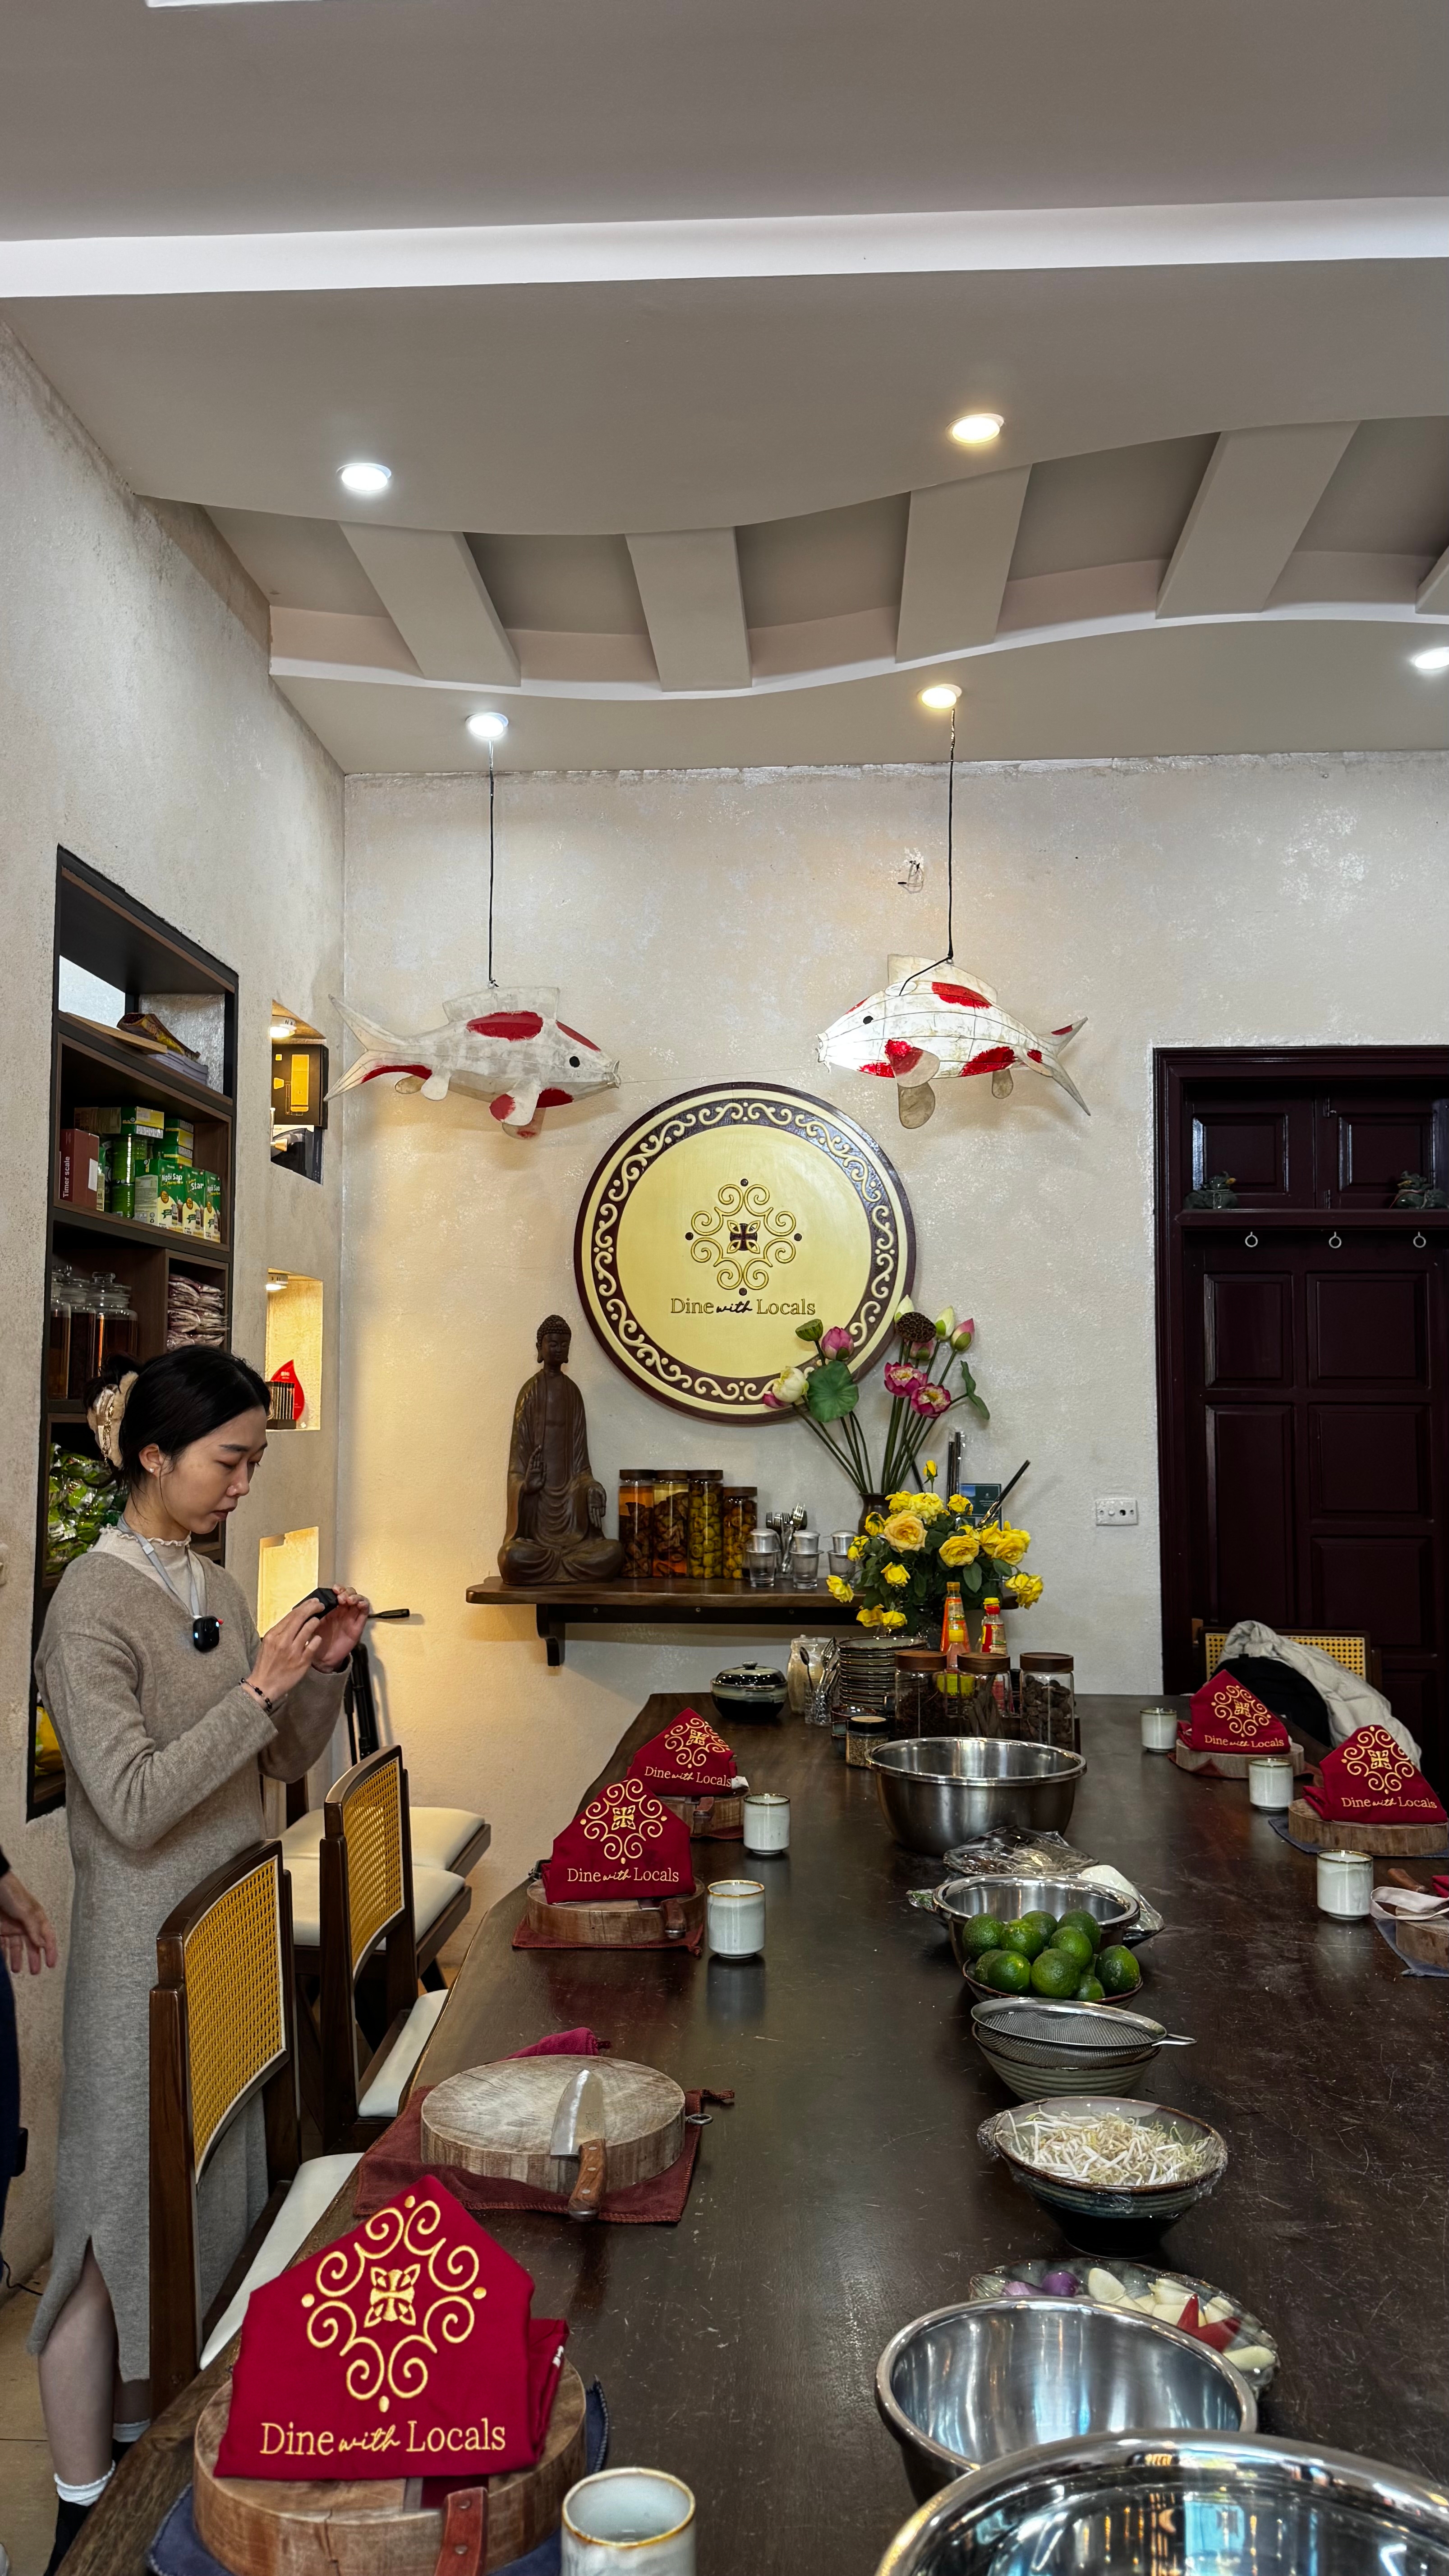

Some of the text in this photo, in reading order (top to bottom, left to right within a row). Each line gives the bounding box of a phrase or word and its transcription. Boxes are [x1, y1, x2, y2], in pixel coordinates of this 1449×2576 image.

[191, 1182, 204, 1191] Star
[671, 1298, 815, 1315] Dine with Locals
[1204, 1735, 1228, 1745] Dine
[1251, 1738, 1284, 1748] Locals
[644, 1766, 731, 1787] Dine with Locals
[1341, 1797, 1437, 1808] Dine with Locals
[567, 1868, 679, 1882] Dine with Locals
[259, 2418, 506, 2455] Dine with Locals
